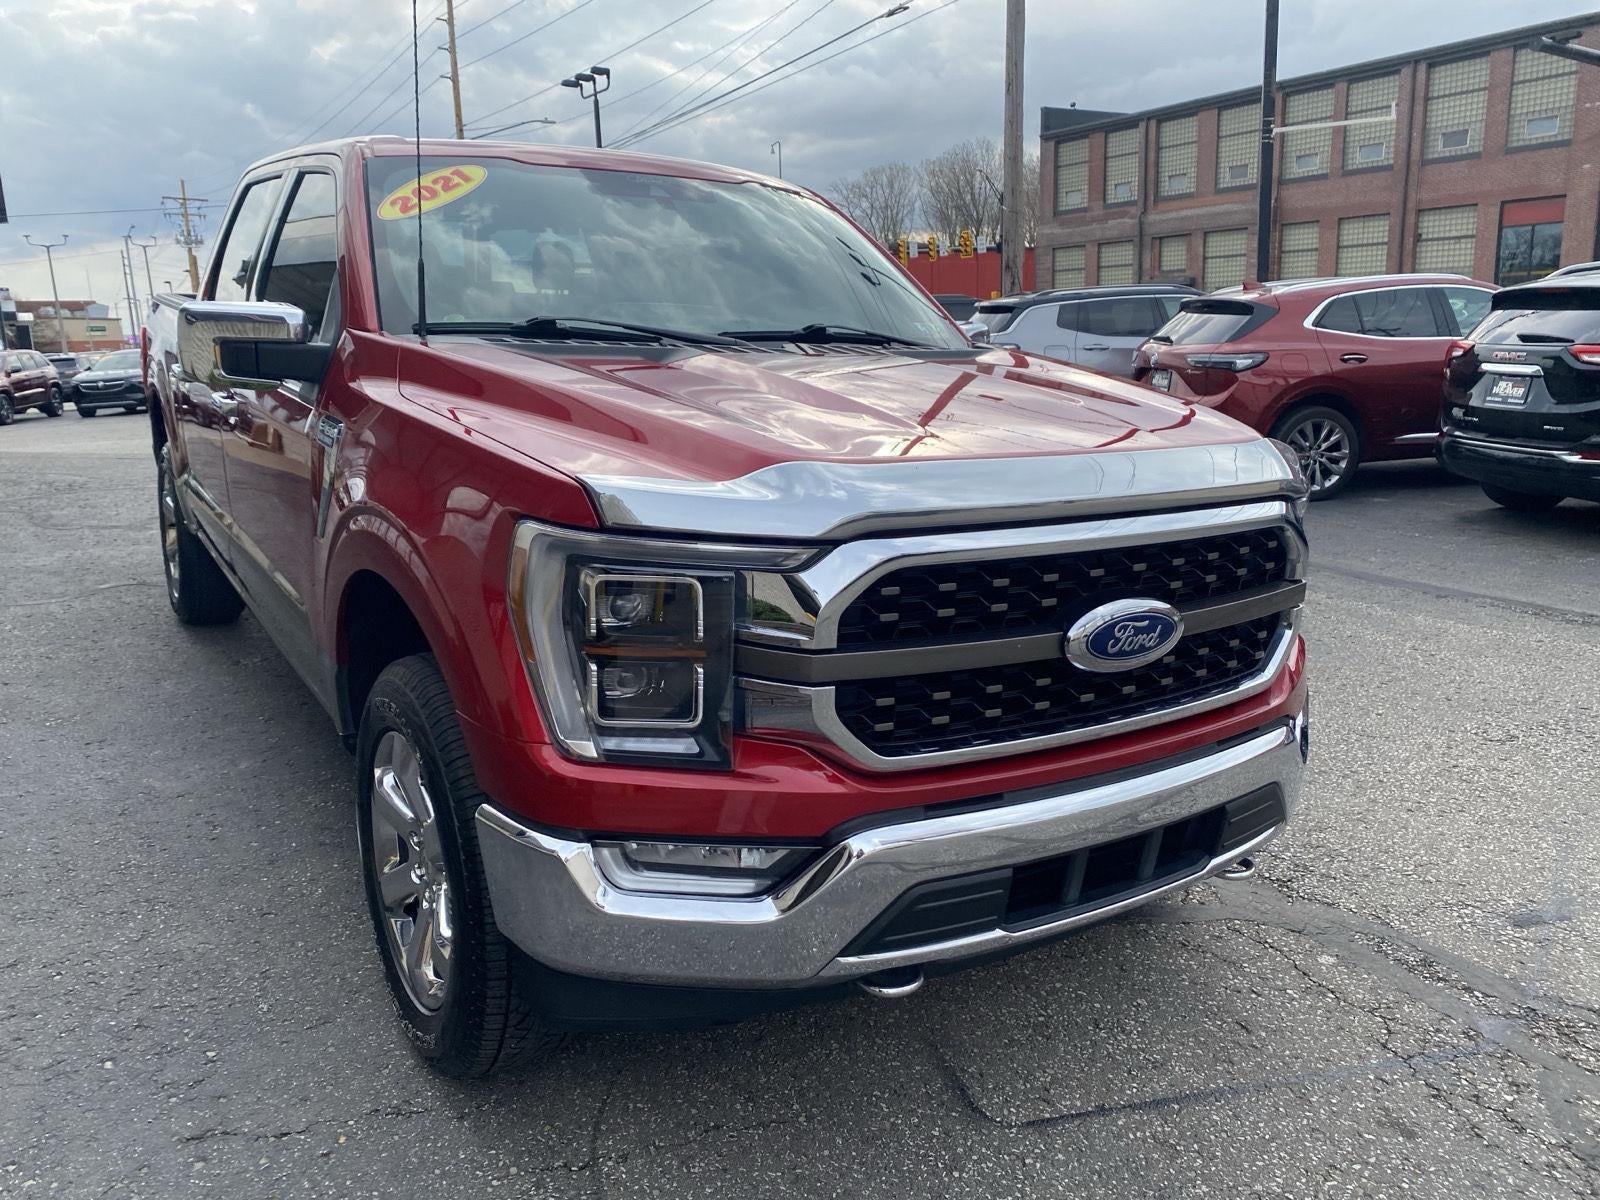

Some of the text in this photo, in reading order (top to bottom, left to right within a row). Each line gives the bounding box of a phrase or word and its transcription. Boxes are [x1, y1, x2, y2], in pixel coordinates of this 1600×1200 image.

[389, 169, 475, 214] 2021
[1492, 352, 1527, 361] GMC
[1492, 386, 1525, 397] WEAVER
[1107, 620, 1162, 654] Ford
